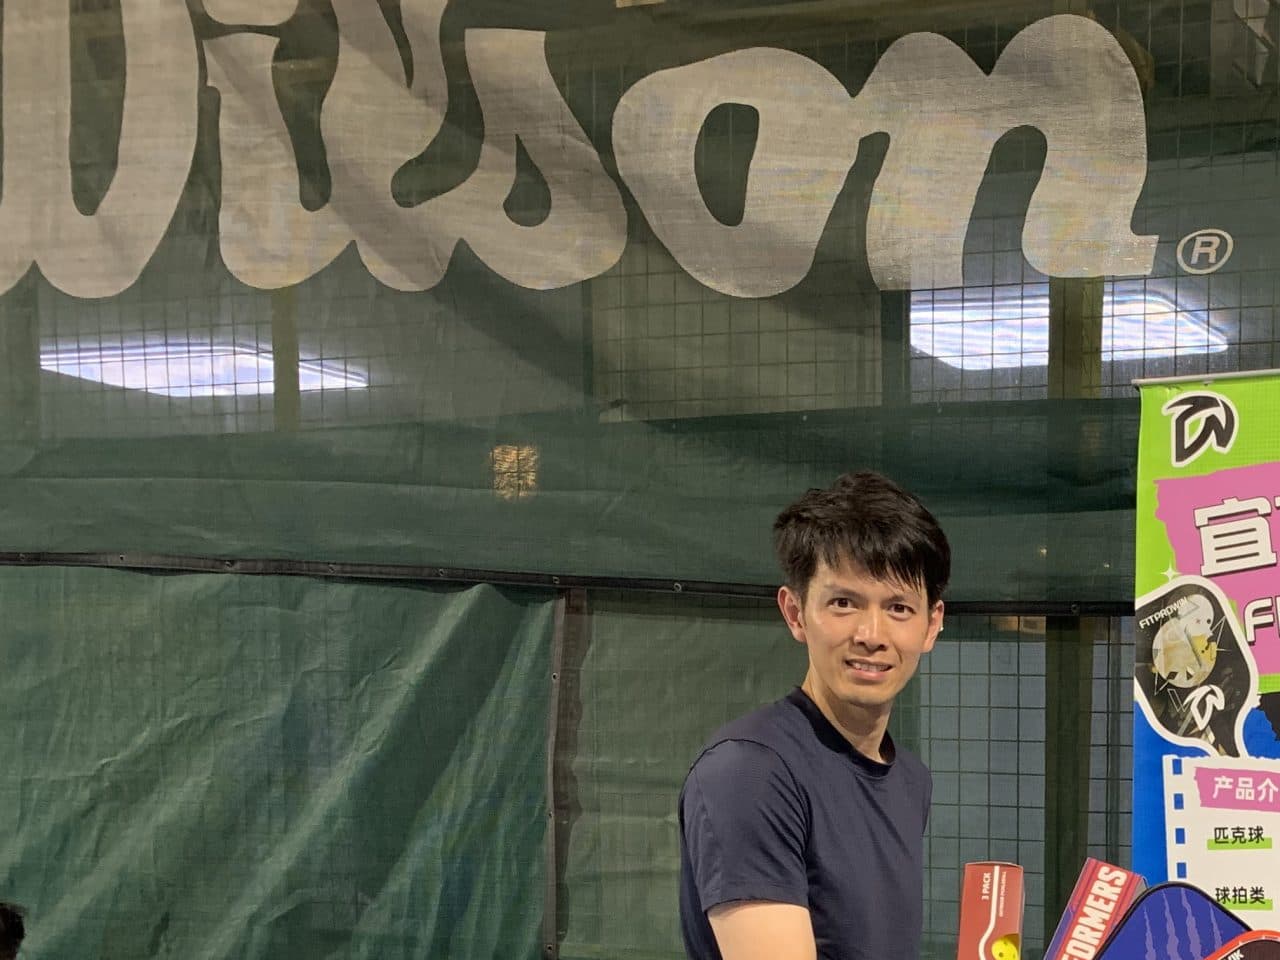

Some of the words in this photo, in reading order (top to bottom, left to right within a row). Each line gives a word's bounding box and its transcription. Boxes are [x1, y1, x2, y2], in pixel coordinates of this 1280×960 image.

[1138, 596, 1188, 629] FITPROWIN
[1213, 826, 1266, 845] 匹克球
[981, 872, 992, 895] PACK
[1214, 886, 1267, 905] 球拍类
